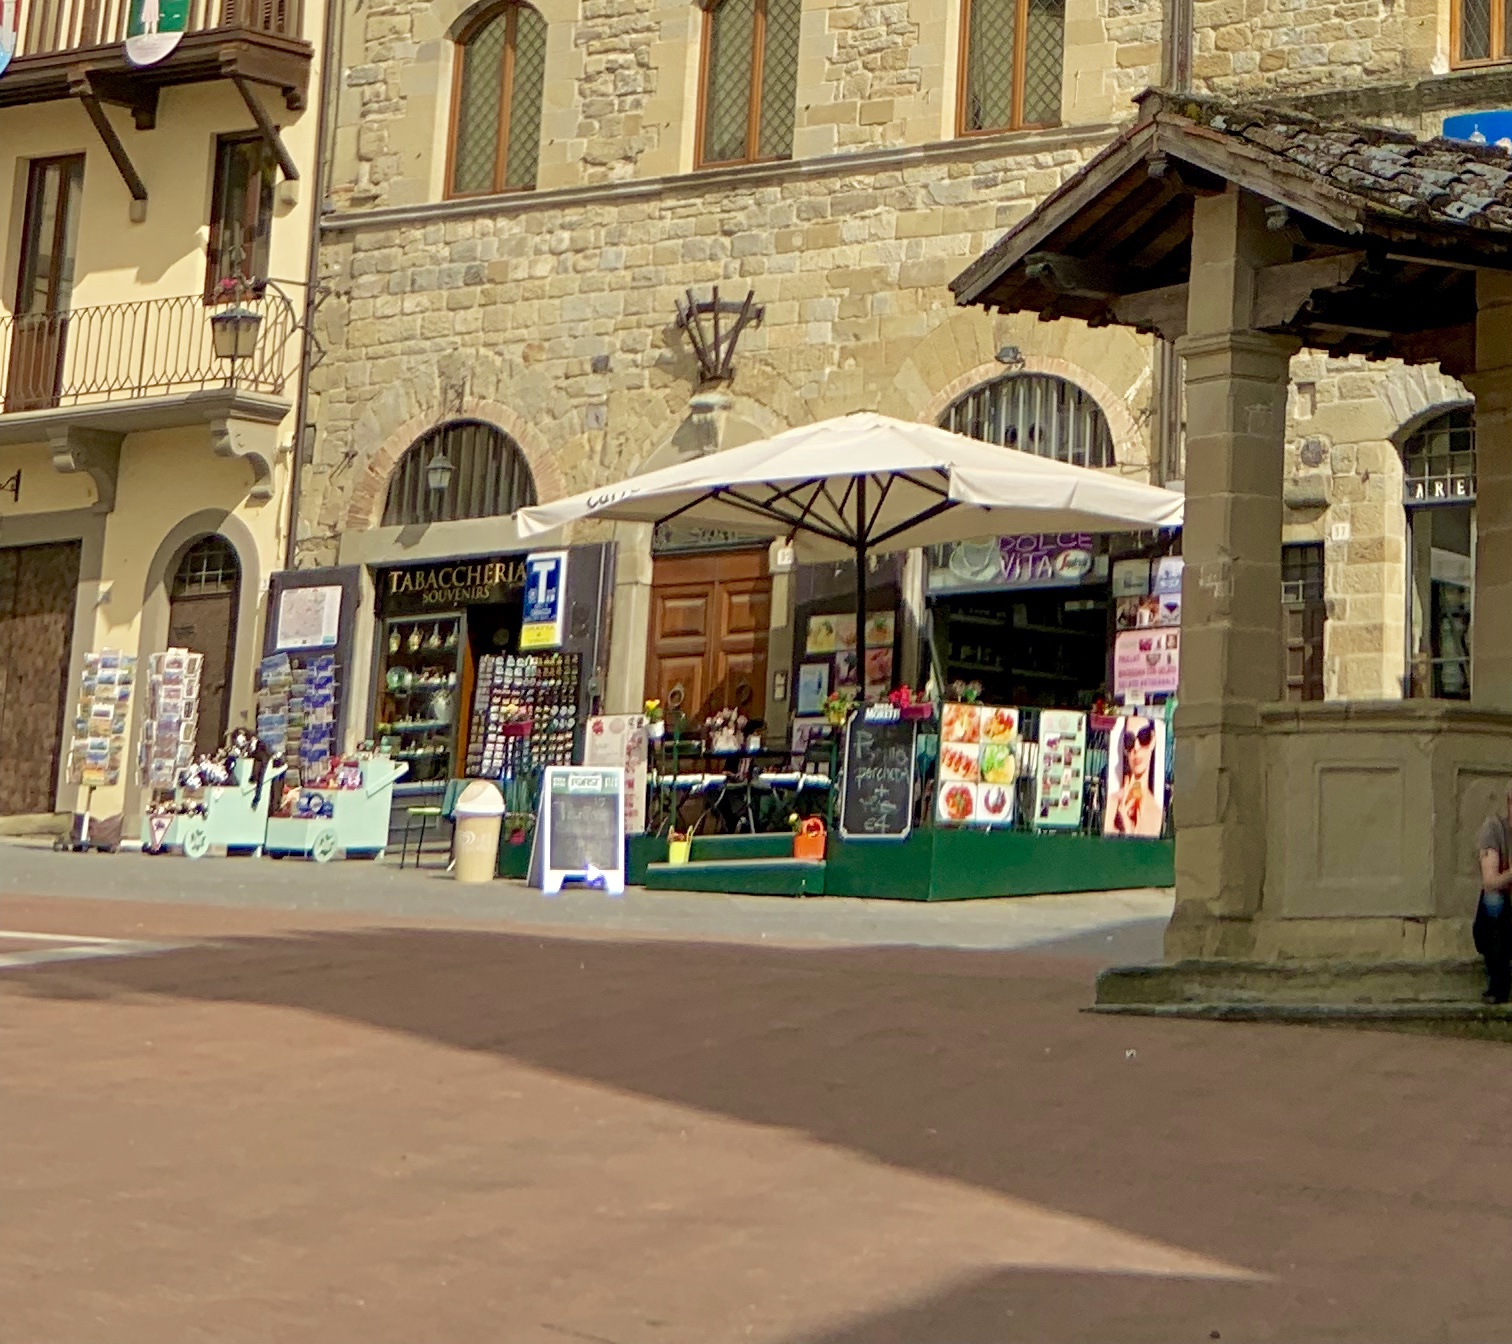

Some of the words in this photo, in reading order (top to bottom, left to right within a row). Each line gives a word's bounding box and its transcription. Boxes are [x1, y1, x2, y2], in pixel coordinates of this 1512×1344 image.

[1415, 479, 1466, 499] ARE
[999, 532, 1093, 551] DOLCE
[388, 562, 527, 593] TABACCHERIA
[532, 561, 557, 604] T
[422, 586, 490, 604] SOUVENIRS
